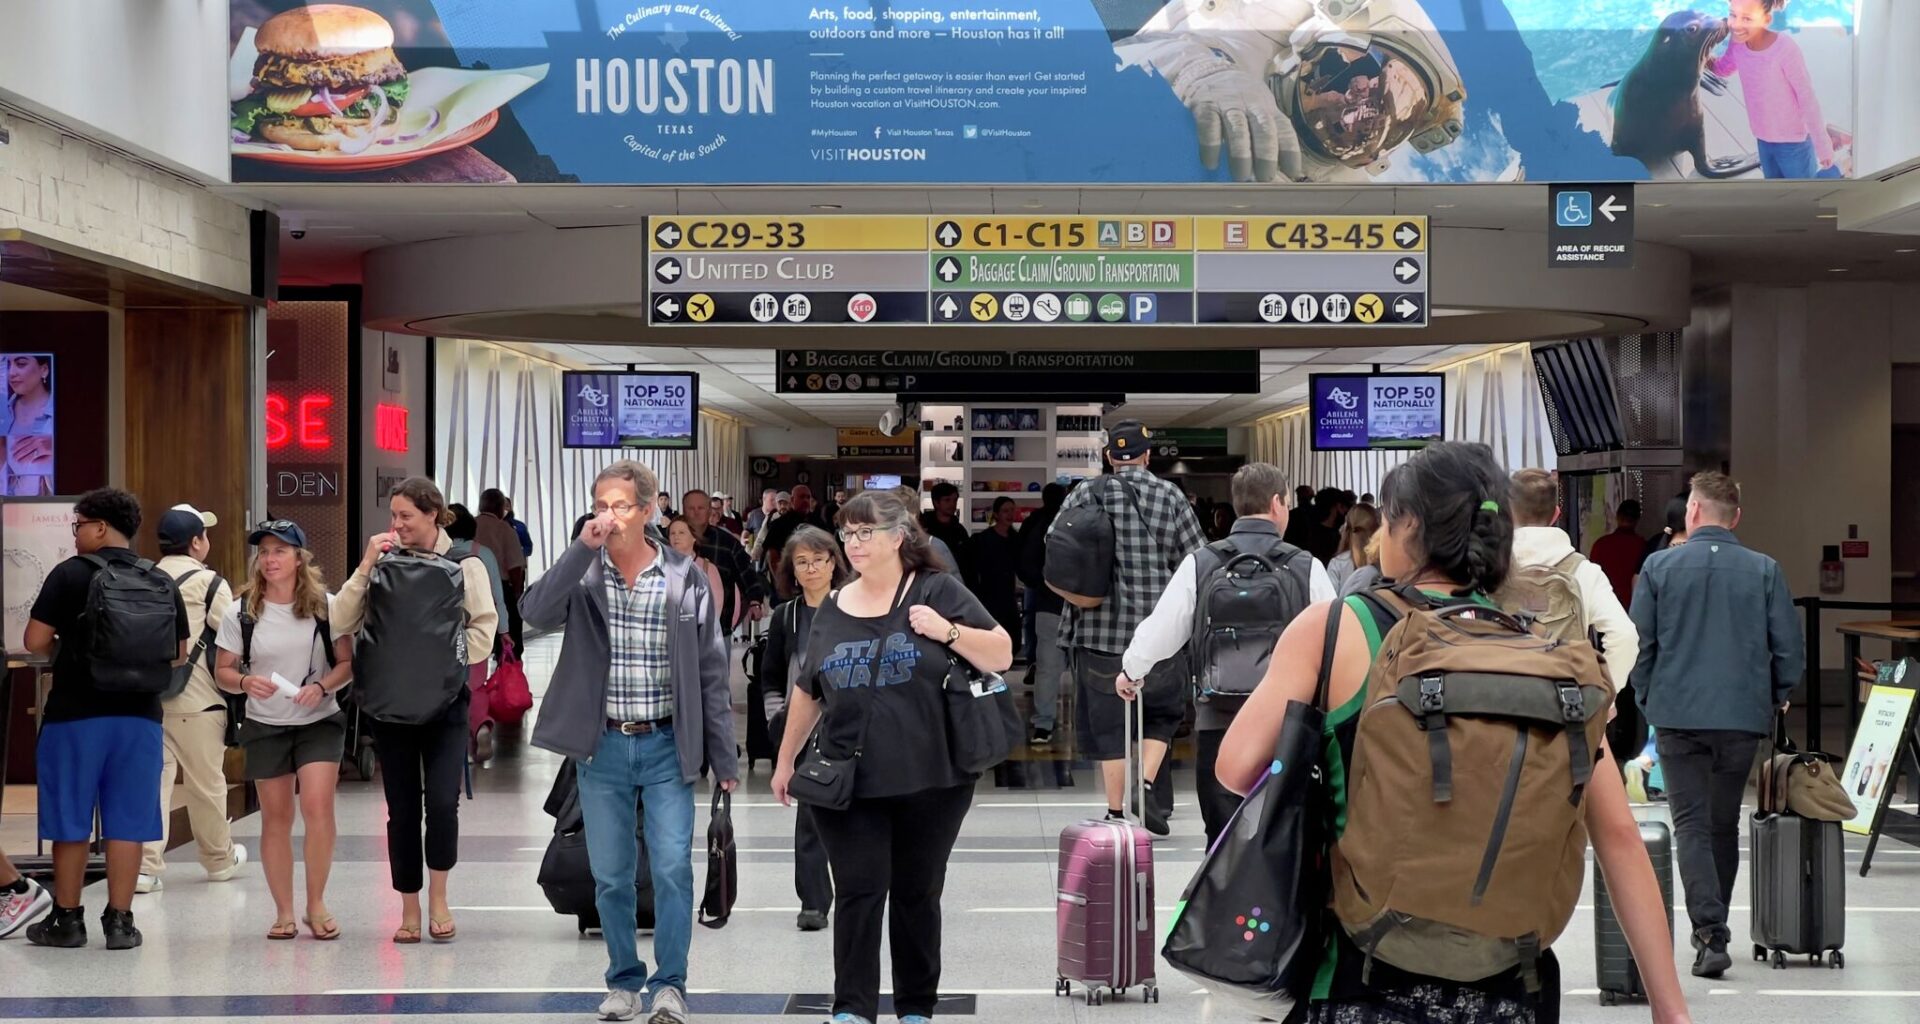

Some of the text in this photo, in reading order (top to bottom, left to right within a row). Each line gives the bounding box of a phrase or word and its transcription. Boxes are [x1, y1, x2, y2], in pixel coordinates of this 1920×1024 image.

[809, 6, 1041, 23] Arts, food, shopping, entertainment,
[606, 4, 743, 41] The Culinary and Cultural
[809, 26, 866, 39] outdoors
[870, 26, 894, 39] and
[898, 29, 930, 39] more
[952, 27, 1004, 39] Houston
[1008, 27, 1030, 39] has
[1034, 27, 1042, 39] it
[1045, 26, 1065, 39] all!
[810, 71, 1085, 83] Planning the perfect getaway is easier than ever! Get started
[576, 57, 775, 114] HOUSTON
[810, 85, 823, 96] by
[825, 84, 861, 96] building
[873, 86, 905, 95] custom
[907, 85, 933, 95] travel
[935, 85, 973, 97] itinerary
[975, 85, 993, 95] and
[996, 86, 1025, 95] create
[1027, 87, 1048, 97] your
[1051, 84, 1087, 96] inspired
[811, 99, 849, 108] Houston
[851, 98, 890, 108] vacation
[893, 99, 902, 108] at
[657, 125, 694, 134] TEXAS
[811, 129, 858, 138] #MyHouston
[887, 128, 954, 137] Visit Houston Texas
[981, 128, 1031, 137] @VisitHouston
[623, 133, 727, 163] Capital of the South
[811, 148, 926, 161] VISITHOUSTON
[687, 222, 805, 248] C29-33
[973, 222, 1173, 247] C1-C15 A B D
[1226, 222, 1384, 249] E C43-45
[687, 257, 835, 280] UNITED CLUB
[970, 255, 1180, 283] BAGGAGE CLAIM/GROUND TRANSPORTATION
[853, 304, 872, 312] AED
[1135, 296, 1153, 320] P
[806, 350, 1135, 368] BAGGAGE CLAIM/GROUND TRANSPORTATION
[905, 375, 917, 390] P
[624, 385, 685, 398] TOP 50
[1374, 386, 1435, 399] TOP 50
[624, 399, 685, 407] NATIONALLY
[1373, 400, 1435, 408] NATIONALLY
[277, 472, 338, 496] DEN
[823, 632, 914, 662] STAR
[824, 657, 916, 690] WARS
